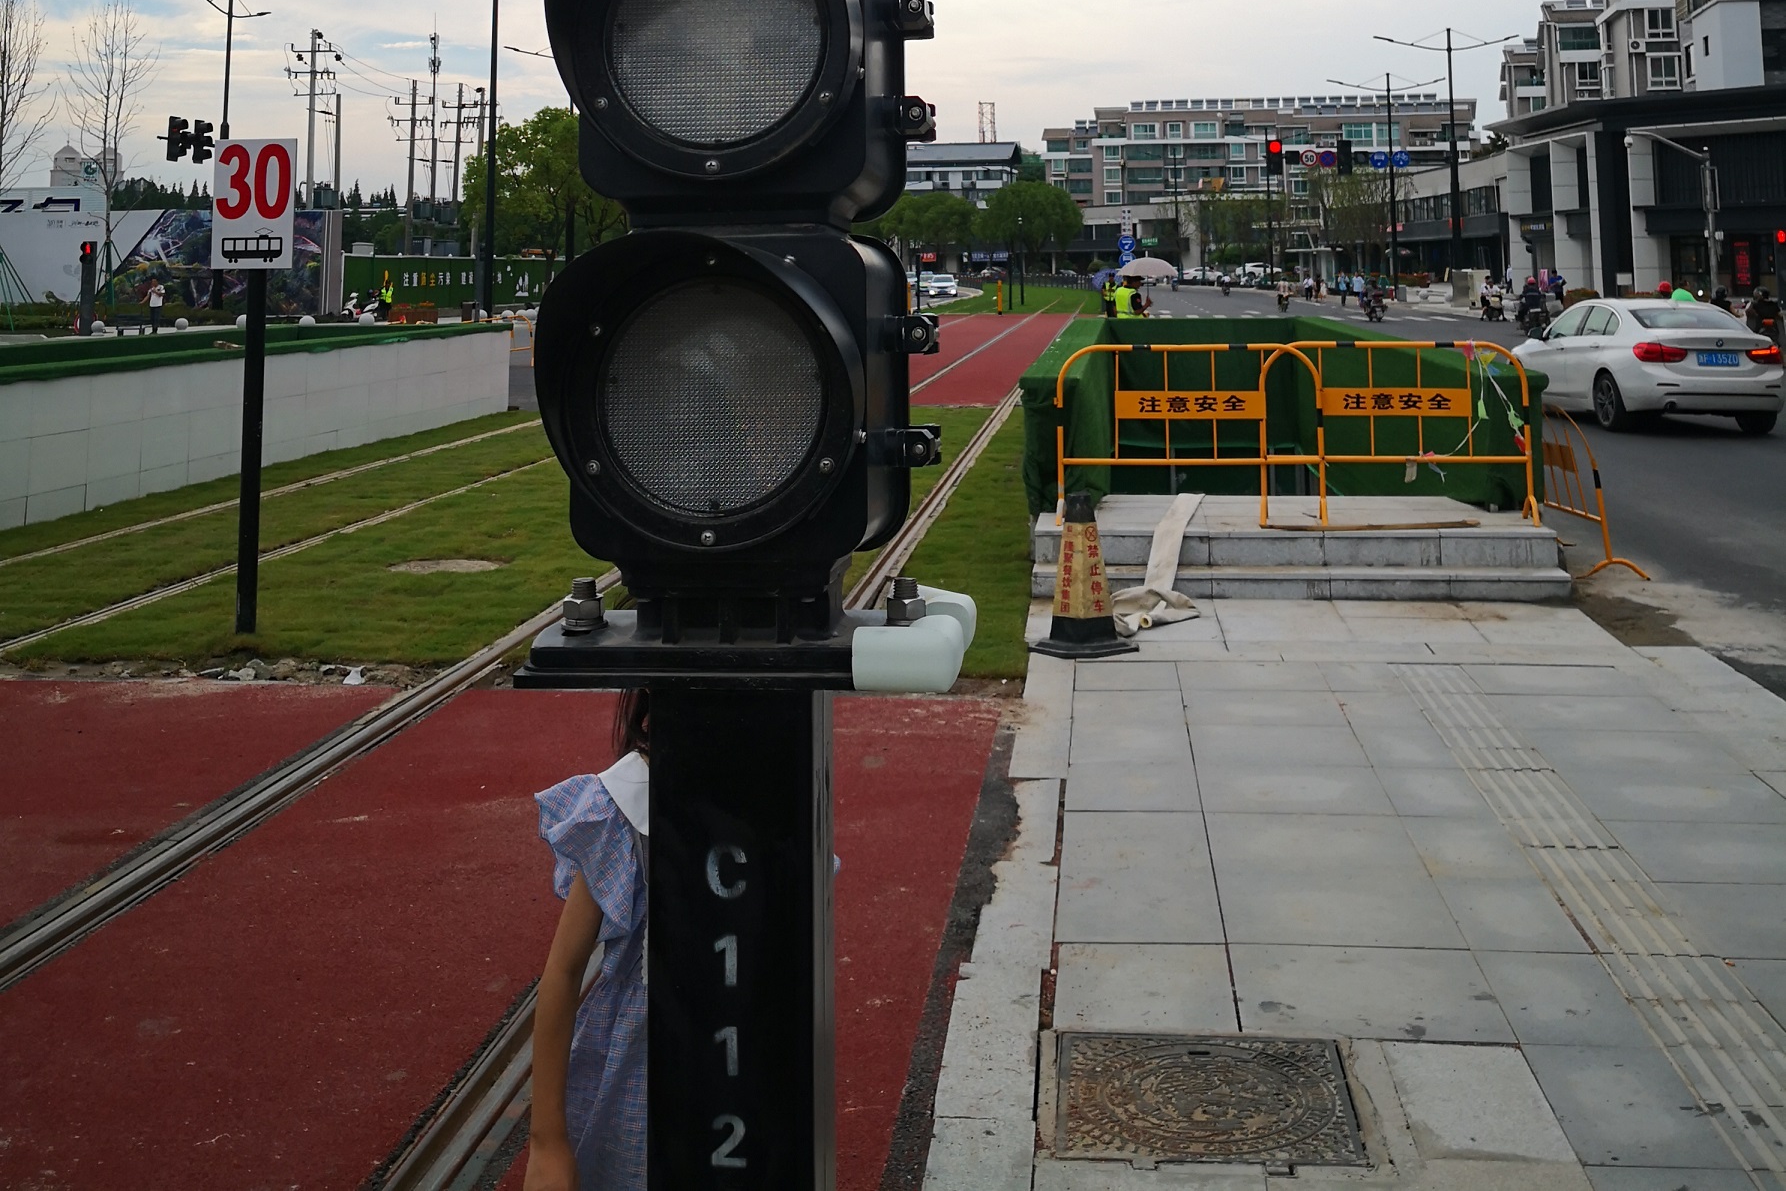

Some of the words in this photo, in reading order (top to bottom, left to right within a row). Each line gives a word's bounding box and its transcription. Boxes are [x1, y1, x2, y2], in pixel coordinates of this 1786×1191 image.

[1304, 154, 1314, 163] 50
[215, 143, 291, 220] 30
[1138, 395, 1246, 413] 注意安全
[1342, 393, 1452, 410] 注意安全
[1087, 544, 1103, 613] 禁止停车
